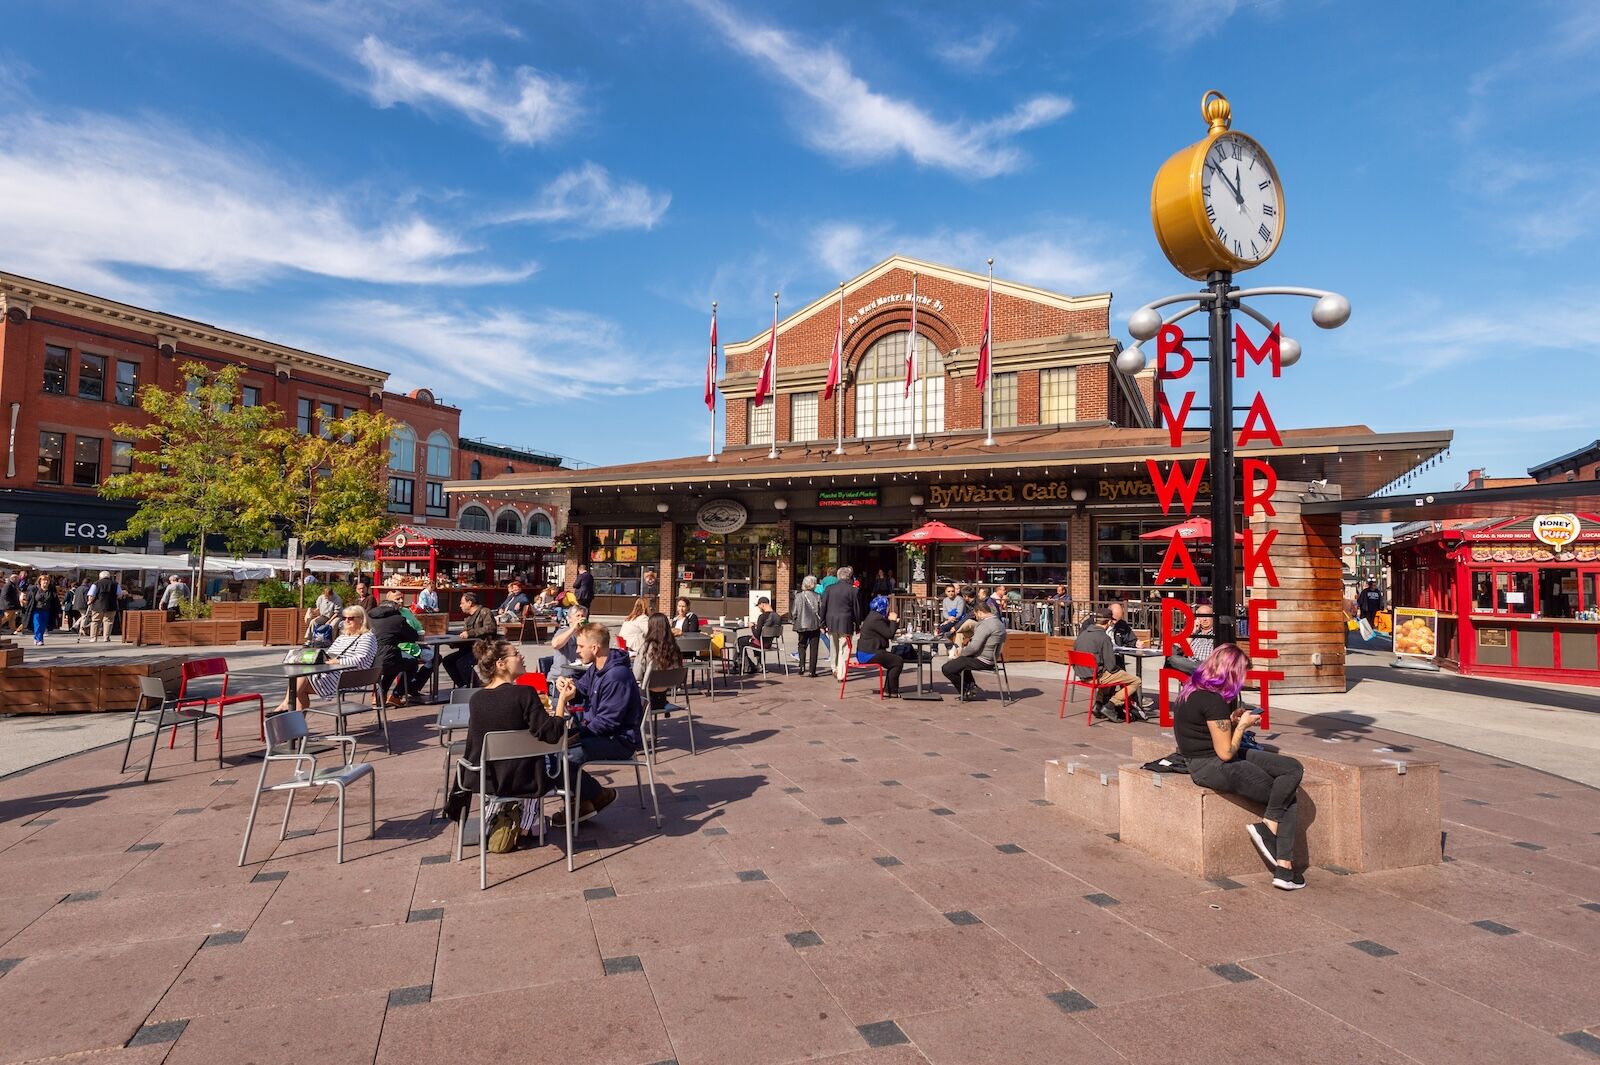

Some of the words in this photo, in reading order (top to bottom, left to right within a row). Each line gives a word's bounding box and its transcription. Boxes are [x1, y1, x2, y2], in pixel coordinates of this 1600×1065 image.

[1231, 143, 1242, 161] XII
[1258, 180, 1269, 191] II
[1263, 204, 1273, 216] III
[848, 315, 859, 325] By
[858, 302, 877, 316] Ward
[934, 300, 944, 312] By
[929, 485, 1015, 508] ByWard
[1022, 481, 1068, 501] Café
[64, 522, 108, 539] EQ3
[1540, 520, 1571, 528] HONEY
[1542, 530, 1570, 540] PUFFS
